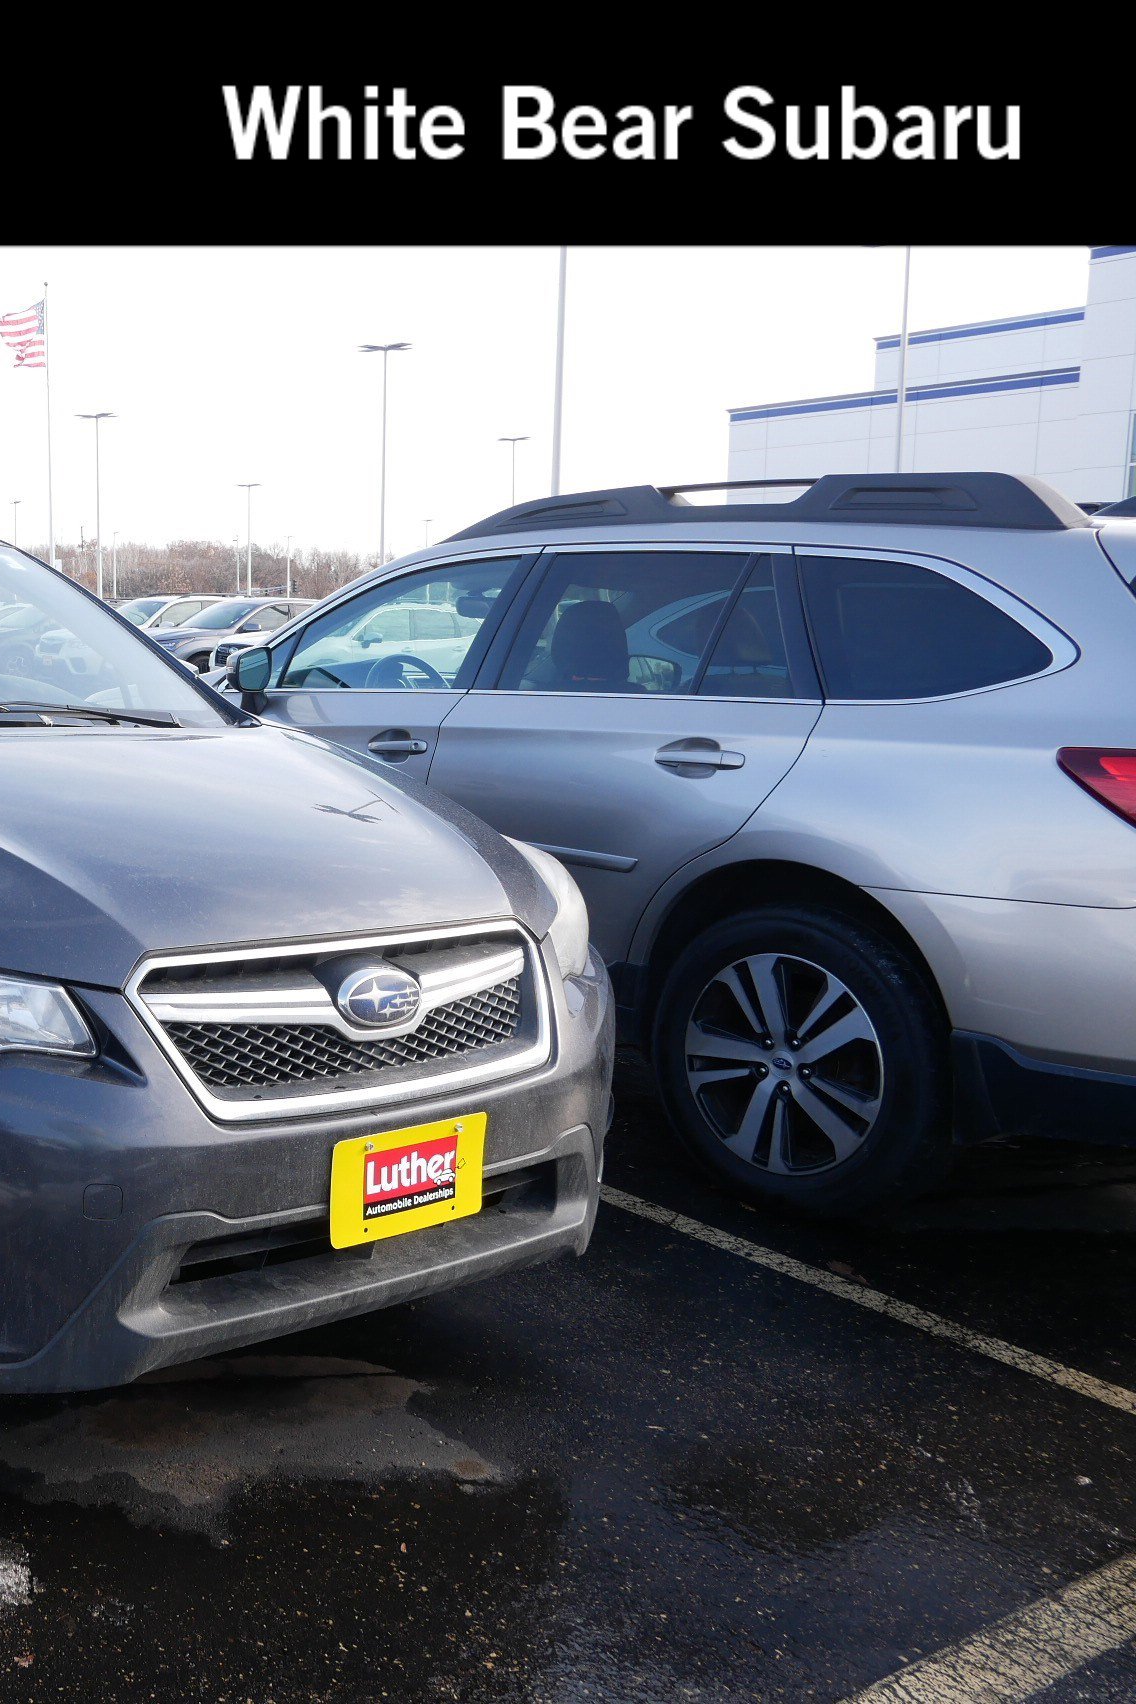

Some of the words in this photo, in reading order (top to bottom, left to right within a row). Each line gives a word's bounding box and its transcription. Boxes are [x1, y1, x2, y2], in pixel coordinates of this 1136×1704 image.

[366, 1150, 456, 1195] Luther
[366, 1197, 412, 1216] Automobile
[414, 1187, 454, 1205] Dealerships
